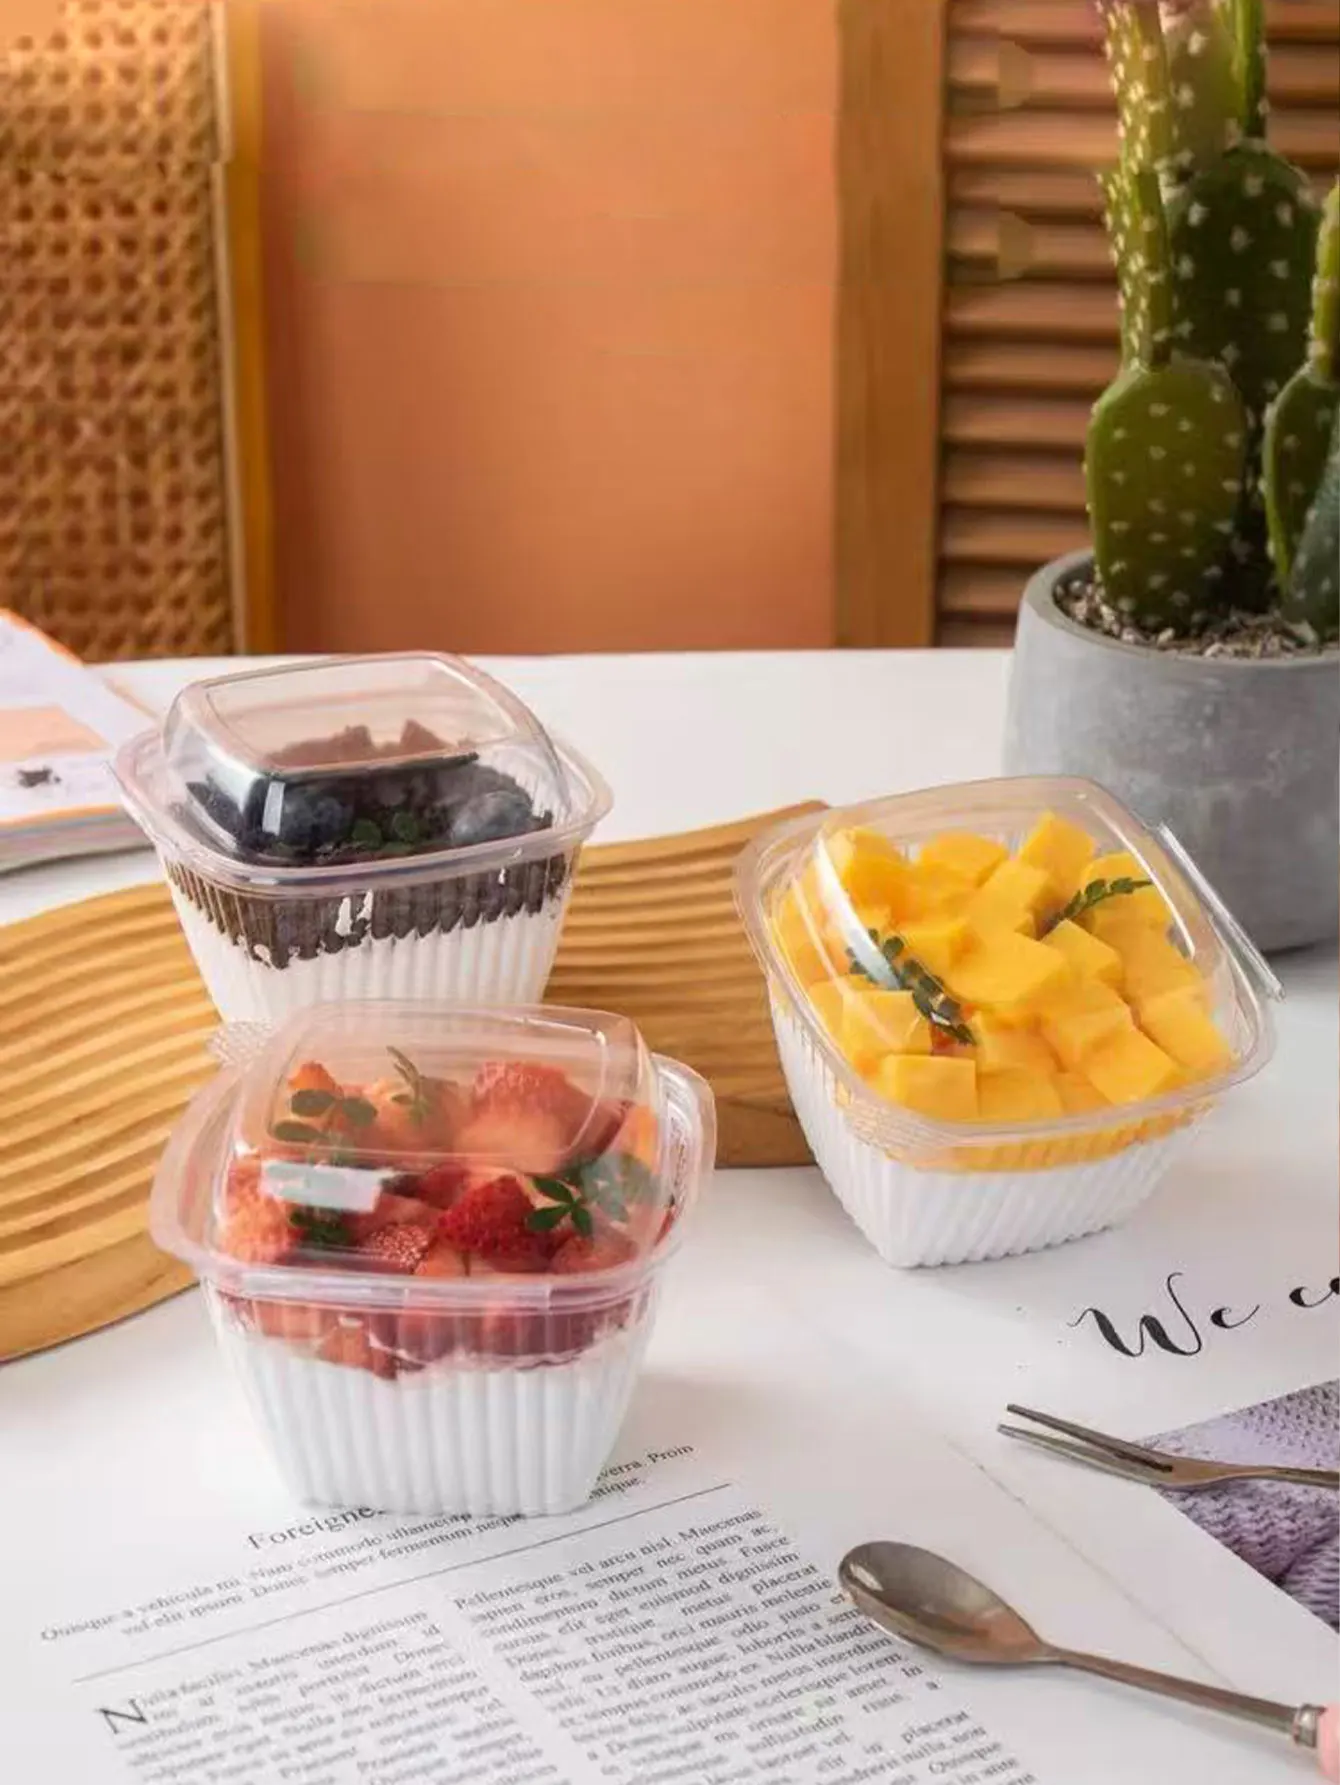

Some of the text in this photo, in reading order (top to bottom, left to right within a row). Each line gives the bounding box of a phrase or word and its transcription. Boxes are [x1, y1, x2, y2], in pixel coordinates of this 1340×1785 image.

[647, 1446, 693, 1463] Proin
[248, 1505, 383, 1549] Foreigne
[678, 1511, 762, 1541] Maecenas
[696, 1535, 743, 1558] quam
[739, 1537, 790, 1557] Fusce
[718, 1552, 800, 1584] dignissim
[751, 1563, 818, 1595] placerat
[761, 1579, 832, 1608] molestie
[731, 1620, 769, 1638] odio
[813, 1634, 894, 1668] interdum
